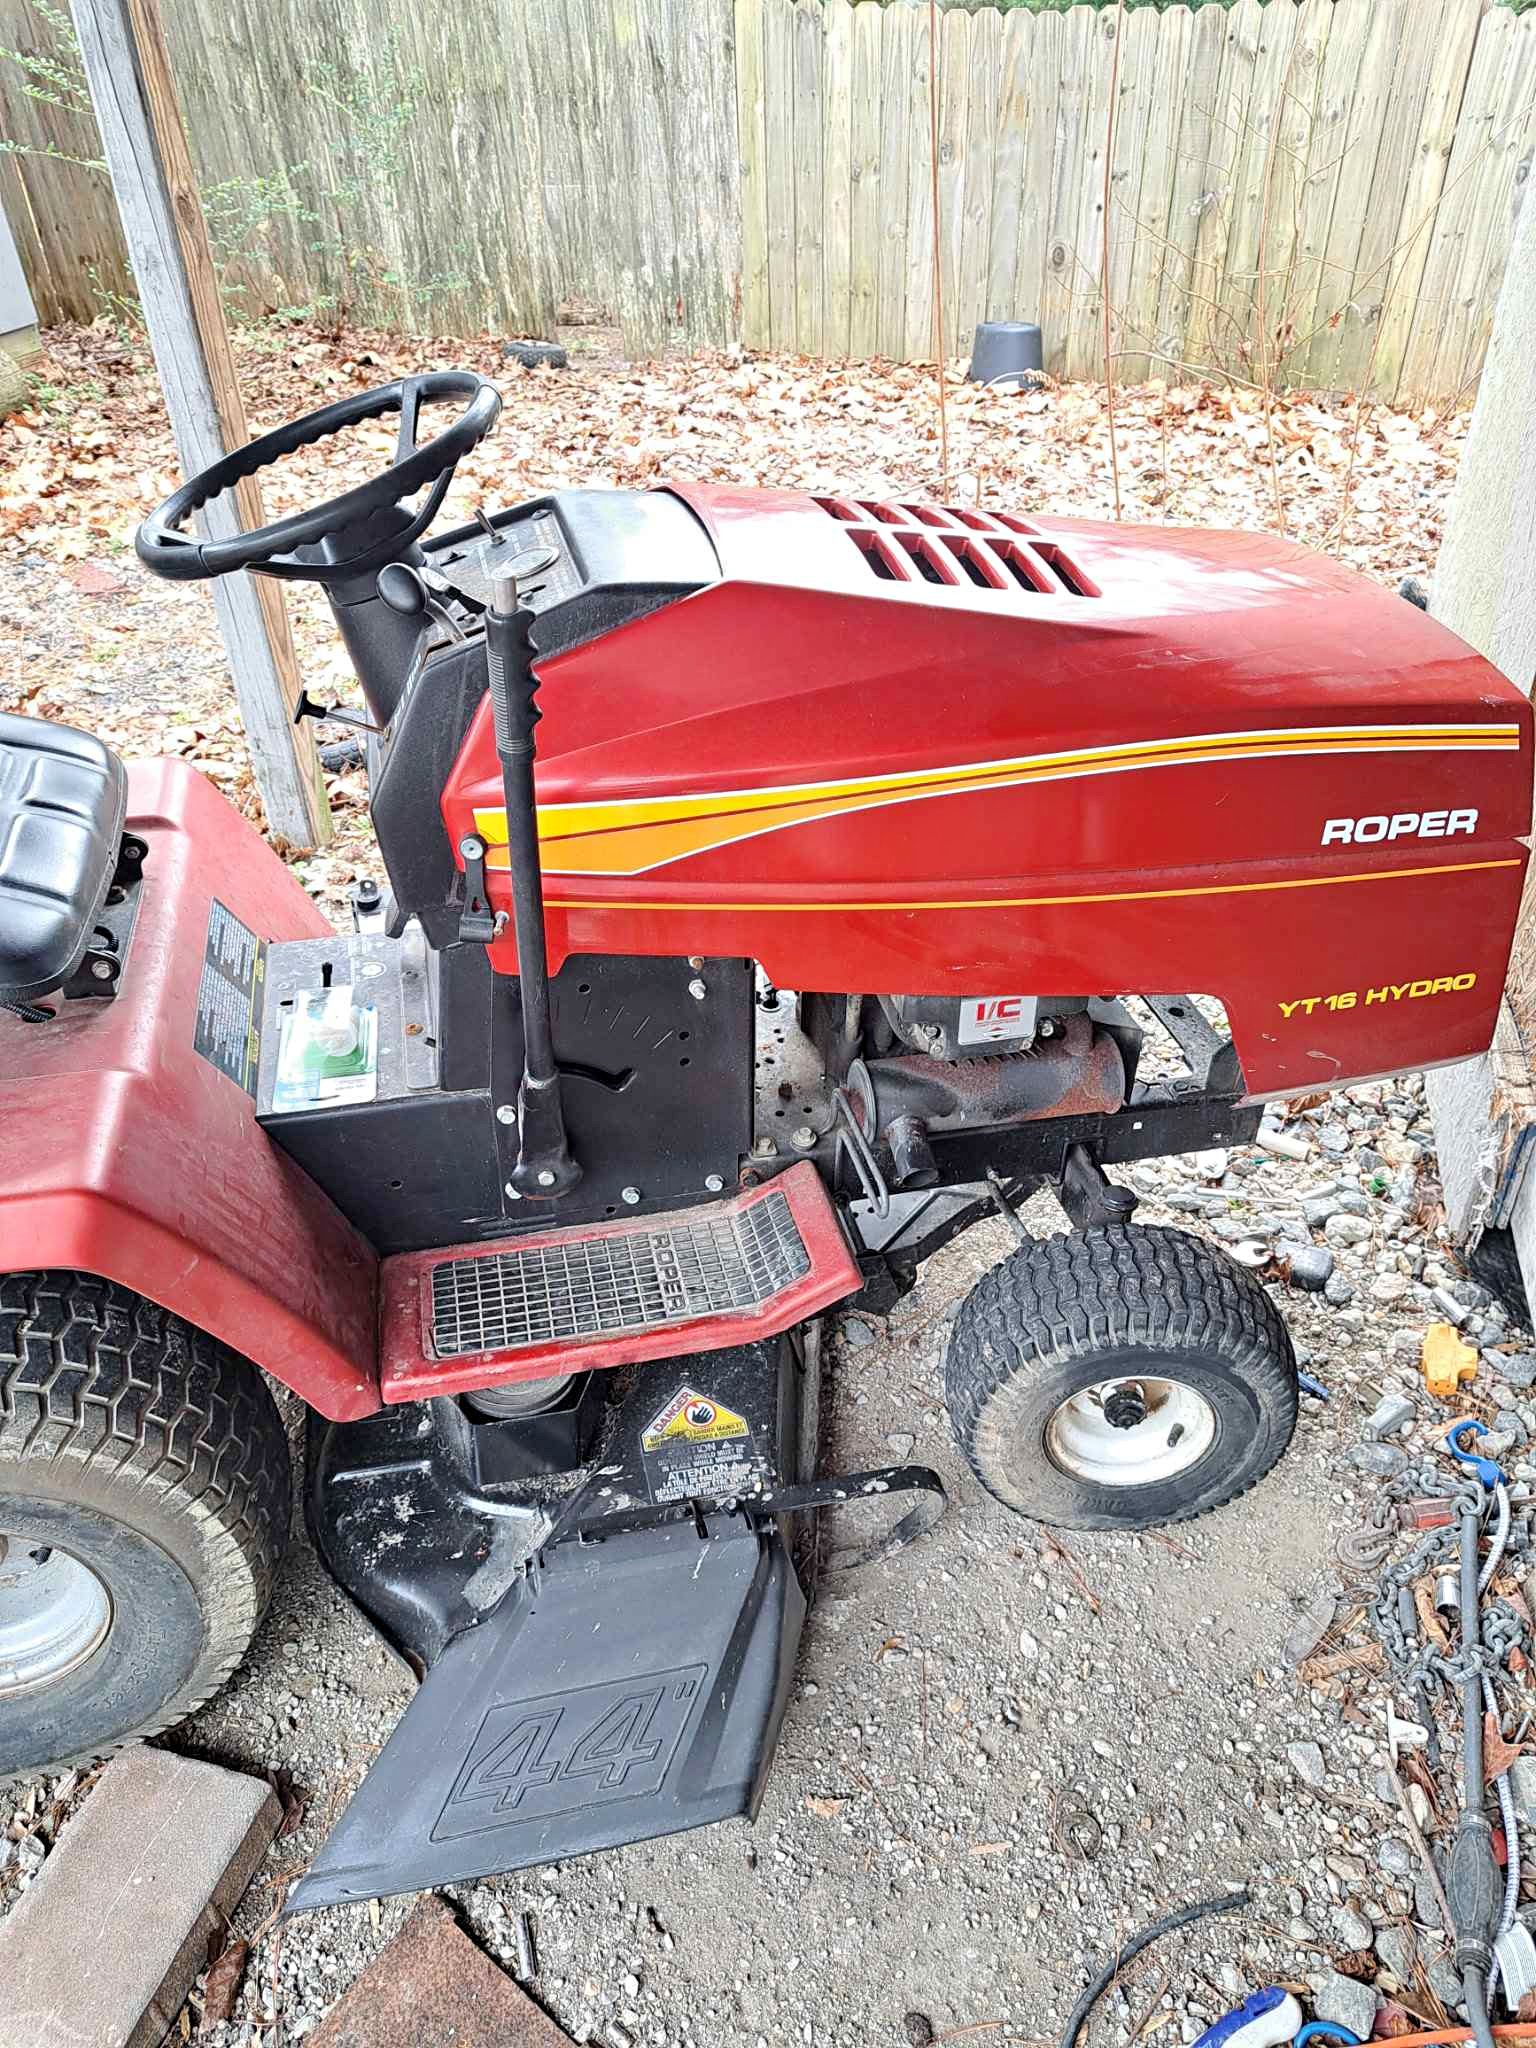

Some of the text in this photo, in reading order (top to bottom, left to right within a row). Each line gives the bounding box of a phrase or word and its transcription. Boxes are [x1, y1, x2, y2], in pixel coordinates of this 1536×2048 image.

[1321, 808, 1478, 845] ROPER
[1365, 972, 1477, 1005] HYDRO
[651, 1232, 687, 1312] ROPER
[653, 1391, 690, 1432] DANGER
[667, 1463, 729, 1481] ATTENTION
